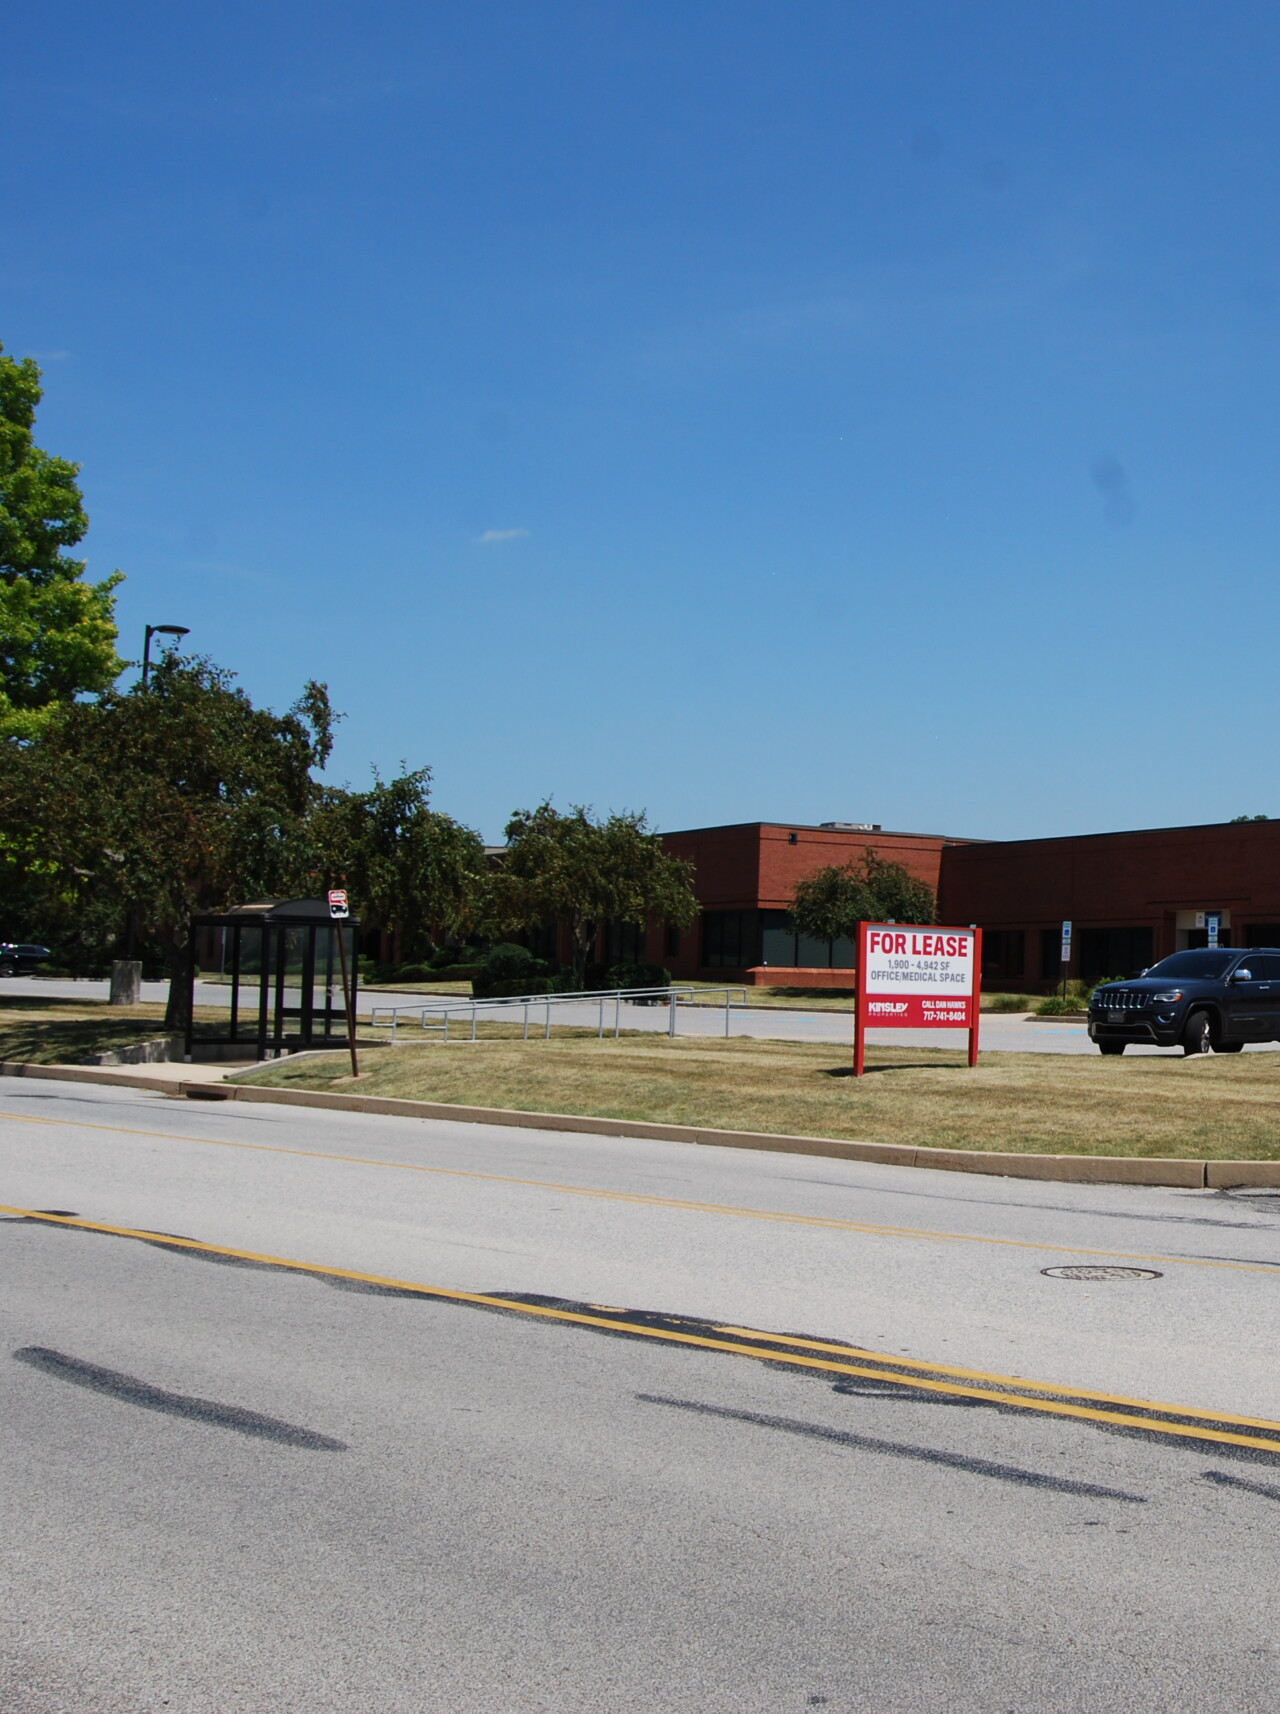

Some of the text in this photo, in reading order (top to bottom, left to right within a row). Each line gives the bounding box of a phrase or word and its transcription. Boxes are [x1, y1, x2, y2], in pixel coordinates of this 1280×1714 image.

[870, 932, 968, 957] FOR LEASE
[888, 959, 909, 970] 1,900
[917, 961, 938, 971] 4,942
[940, 961, 950, 971] SF
[871, 970, 965, 983] OFFICE/MEDICAL SPACE
[868, 1002, 908, 1012] KINSLEY
[921, 1000, 936, 1009] CALL
